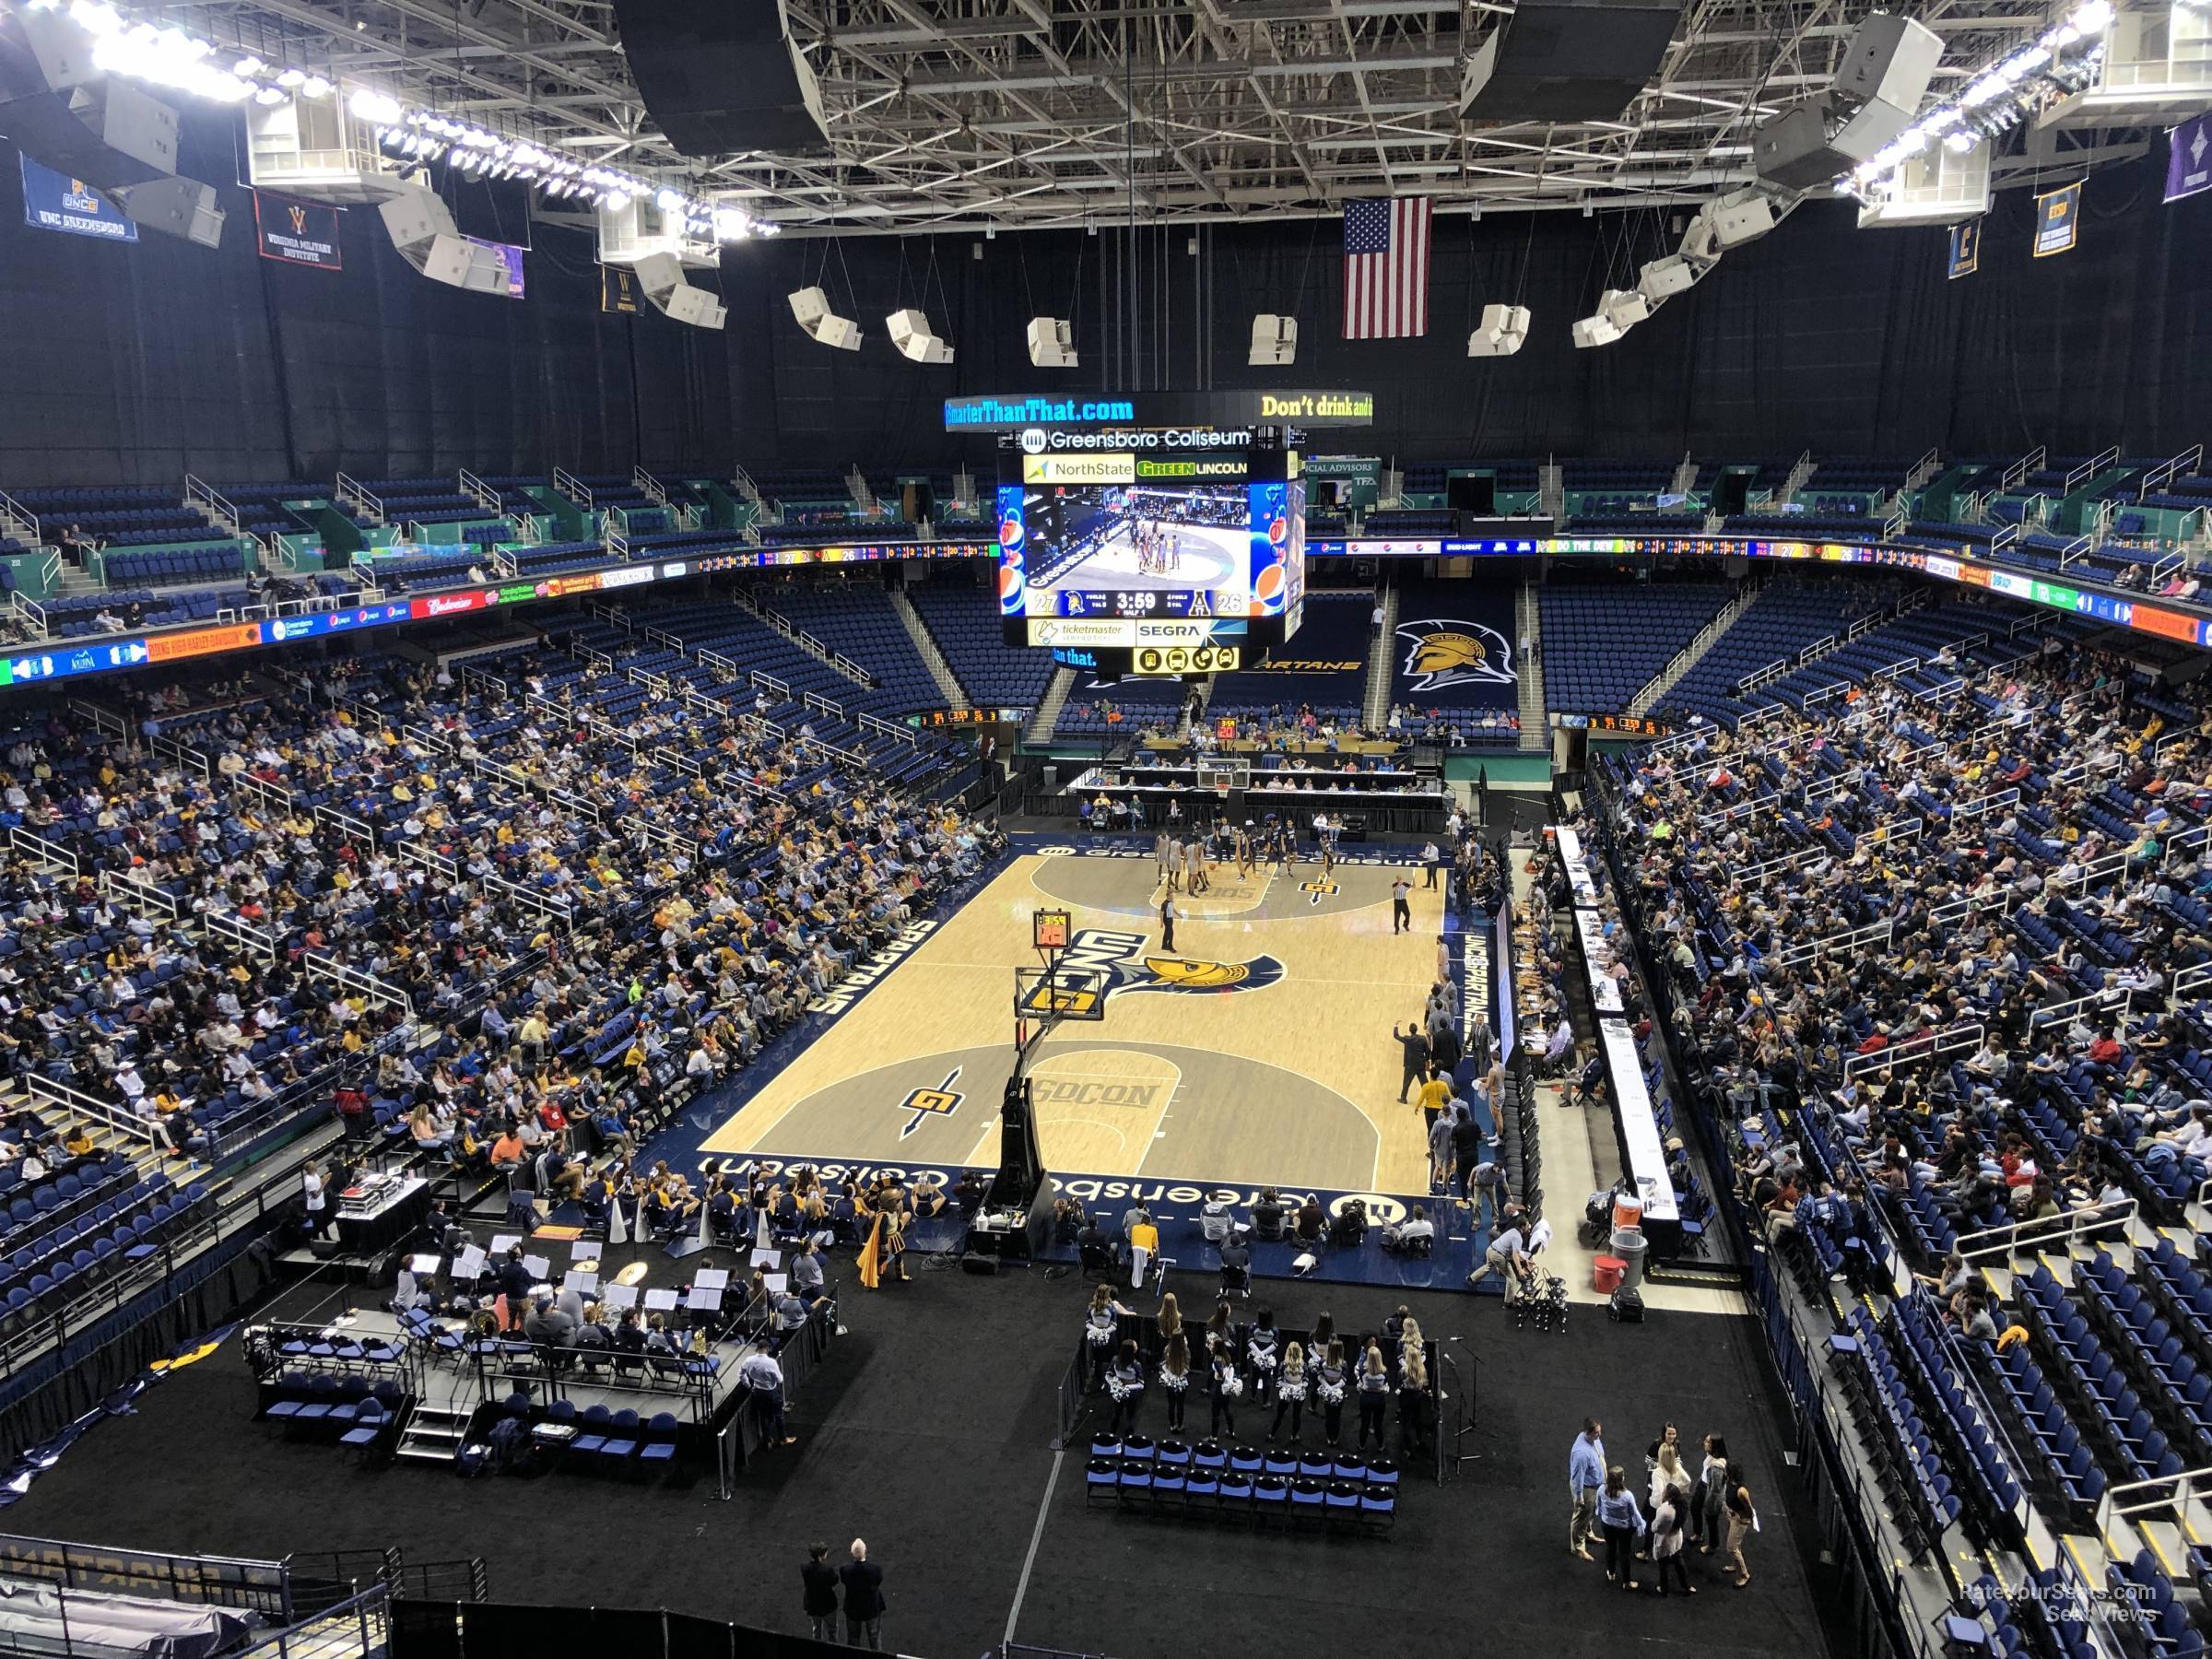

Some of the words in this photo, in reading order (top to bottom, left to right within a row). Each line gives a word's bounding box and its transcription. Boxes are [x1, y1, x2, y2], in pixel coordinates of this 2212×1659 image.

[40, 211, 61, 225] UNC
[63, 215, 125, 235] GREENSBORO
[267, 233, 299, 249] VIRGINIA
[300, 241, 331, 253] MILITARY
[945, 396, 1135, 426] SmarterThanThat.com
[1262, 395, 1313, 417] Don't
[1316, 394, 1353, 417] drink
[1050, 431, 1159, 448] Greensboro
[1165, 429, 1251, 447] Coliseum
[1055, 463, 1133, 476] NorthState
[1137, 461, 1195, 477] GREEN
[1196, 463, 1248, 475] LINCOLN
[1329, 464, 1372, 472] ADVISORS
[1355, 477, 1378, 486] TFA
[1556, 540, 1570, 551] DO
[1573, 540, 1591, 551] THE
[1594, 540, 1614, 551] DEW
[1637, 542, 1642, 550] 0
[1660, 542, 1665, 550] 1
[1681, 542, 1689, 551] 13
[1704, 543, 1713, 551] 14
[841, 551, 855, 561] 26
[1782, 546, 1794, 558] 27
[1841, 548, 1853, 560] 26
[784, 554, 796, 565] 27
[1034, 594, 1057, 613] 27
[1117, 593, 1156, 609] 3:59
[1218, 594, 1242, 613] 26
[1062, 624, 1123, 634] ticketmaster
[1139, 626, 1200, 636] SEGRA
[1067, 648, 1098, 666] that.
[1264, 660, 1362, 670] ARTANS
[1592, 720, 1597, 728] 3
[1220, 727, 1233, 737] 20
[1043, 915, 1065, 925] 3:59
[1032, 1078, 1161, 1109] SOCON
